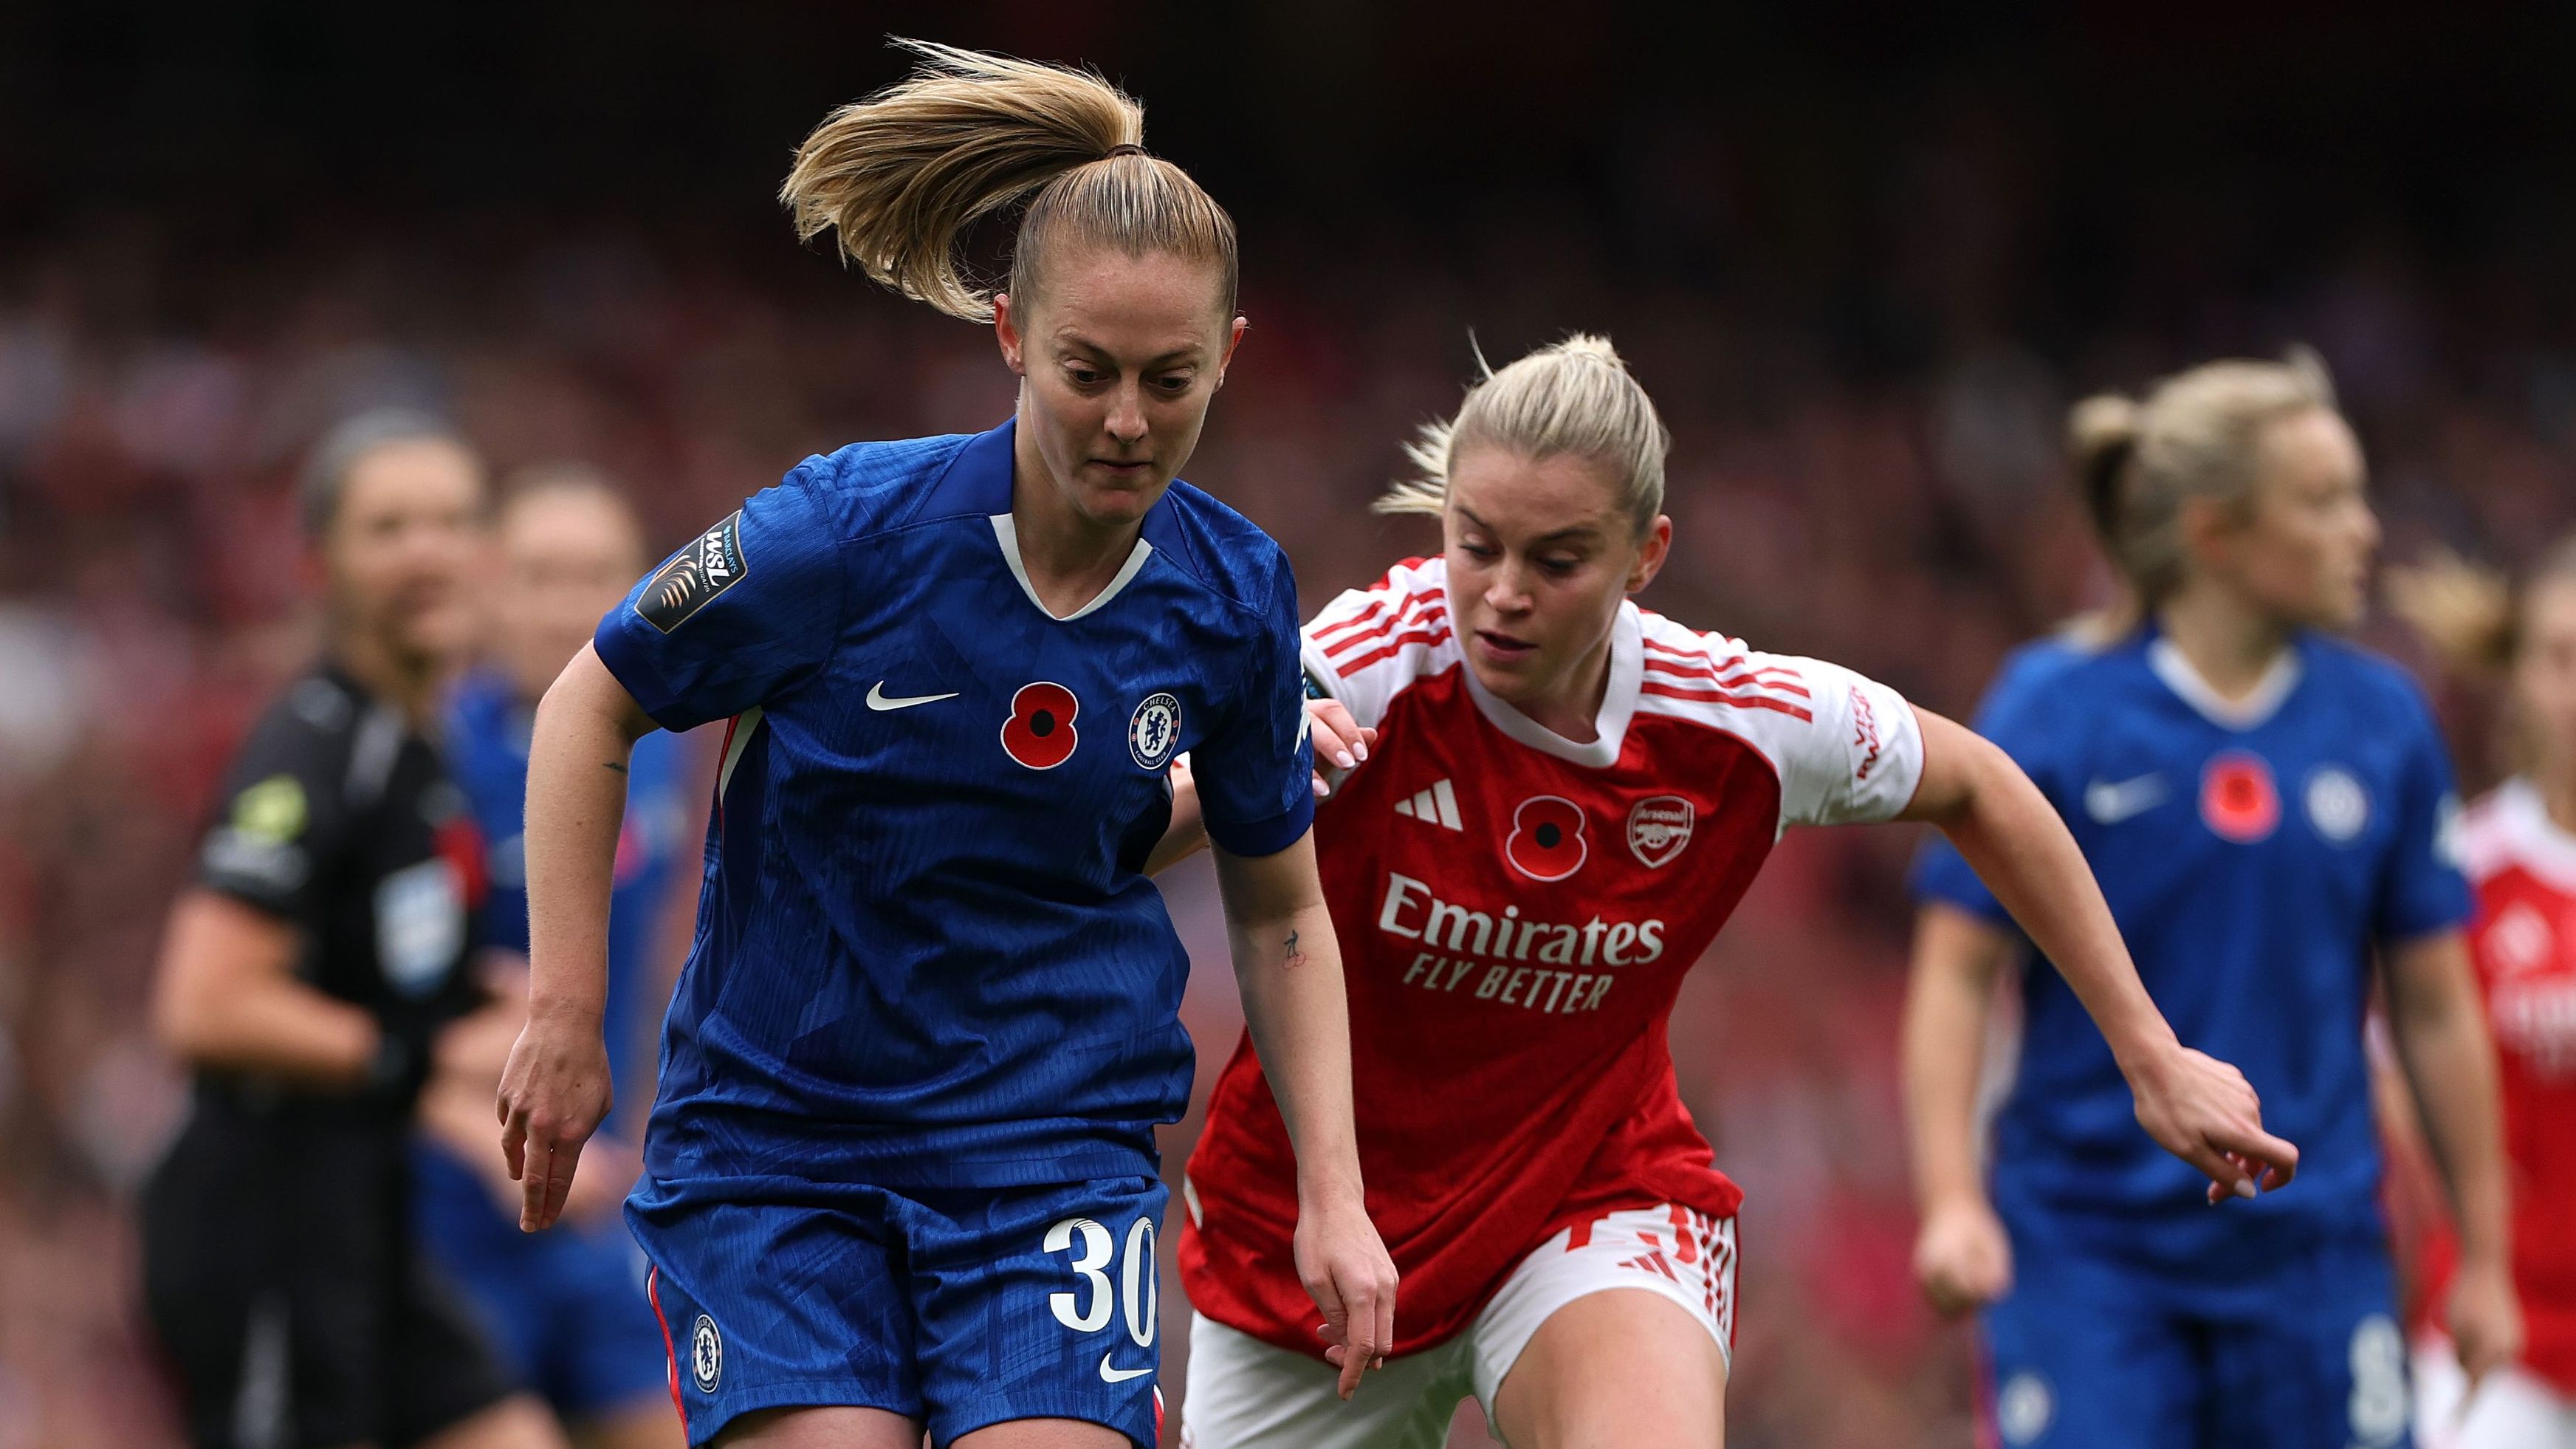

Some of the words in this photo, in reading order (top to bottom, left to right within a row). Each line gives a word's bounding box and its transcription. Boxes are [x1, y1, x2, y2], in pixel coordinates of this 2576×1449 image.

[706, 531, 730, 586] WSL
[724, 534, 738, 573] BARCLAYS
[1143, 696, 1177, 713] CHELSEA
[1378, 871, 1665, 967] Emirates
[1403, 952, 1474, 993] FLY
[1474, 964, 1614, 1015] BETTER
[1043, 1216, 1156, 1348] 30
